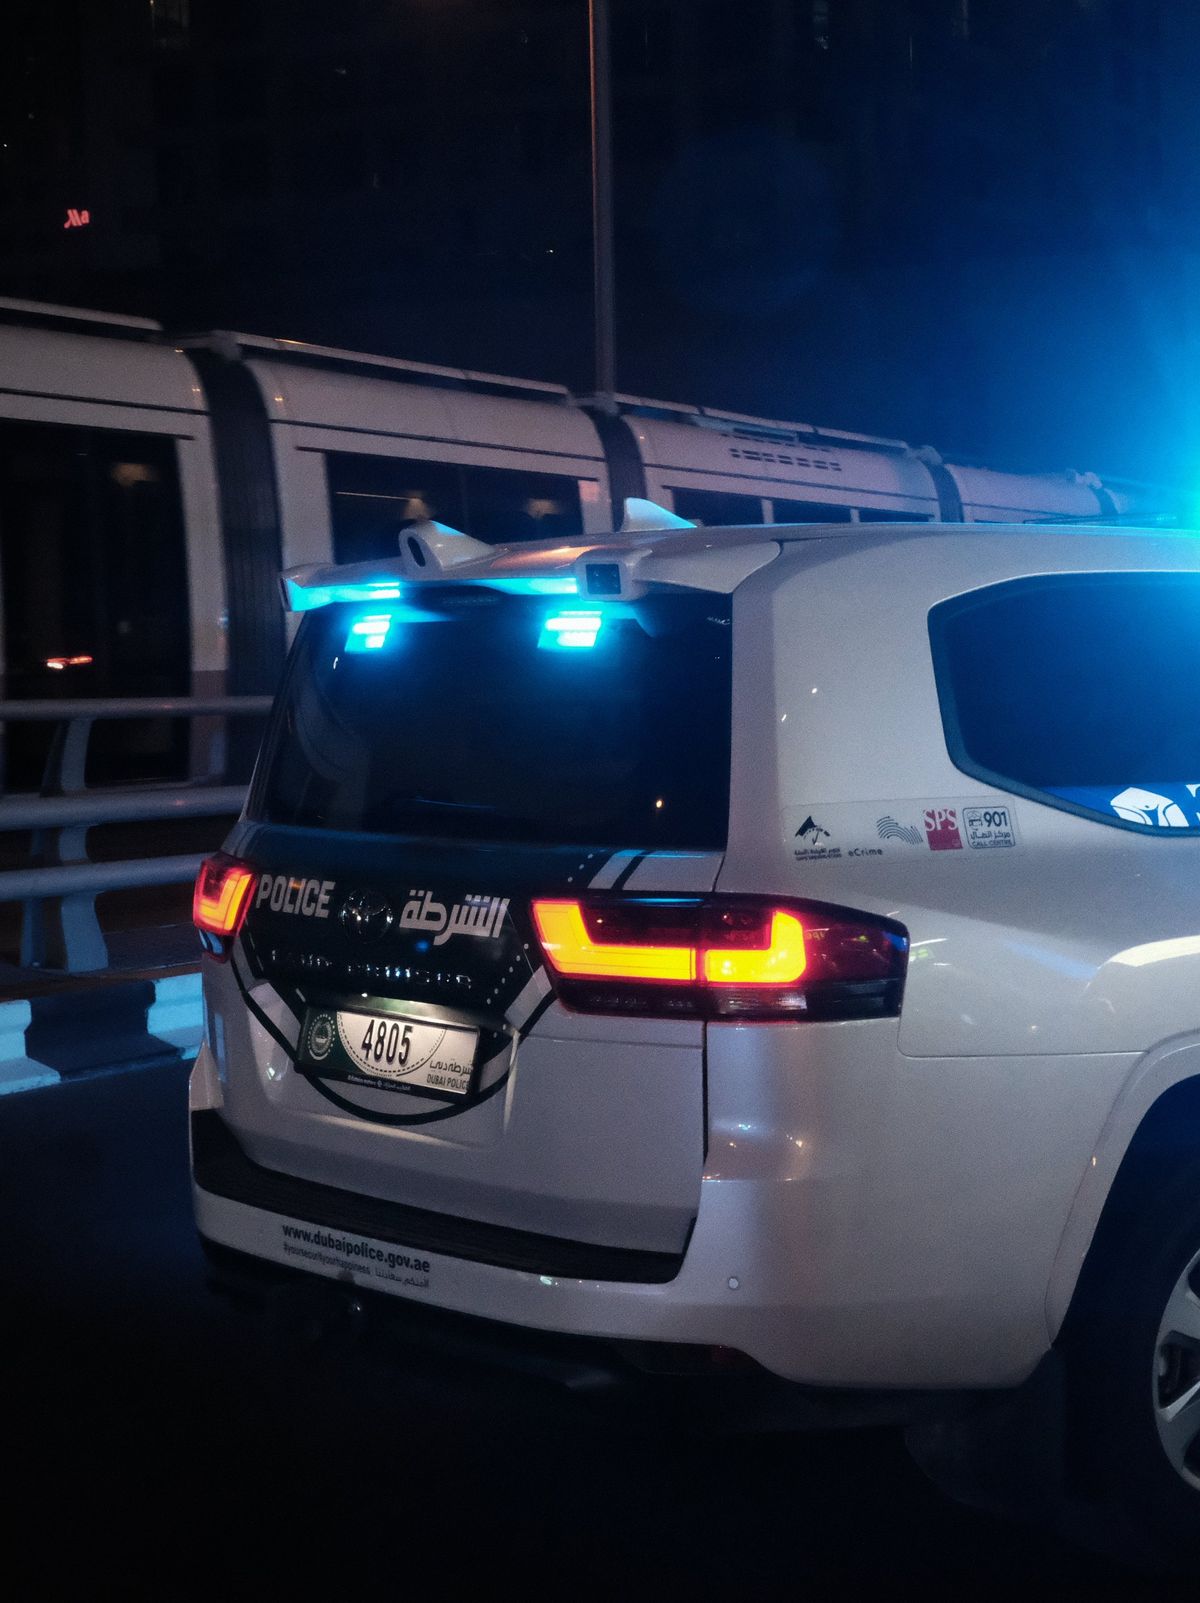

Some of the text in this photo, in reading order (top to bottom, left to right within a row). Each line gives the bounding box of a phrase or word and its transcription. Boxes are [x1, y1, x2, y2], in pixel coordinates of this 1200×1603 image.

[923, 807, 958, 831] SPS
[983, 811, 1008, 828] 901
[847, 847, 883, 857] eCrime
[255, 873, 336, 919] POLICE
[399, 889, 511, 947] الشرطة
[361, 1018, 414, 1066] 4805
[427, 1073, 446, 1086] DUBAI
[447, 1077, 470, 1090] POLIC
[282, 1224, 431, 1273] www.dubaipolice.gov.ae
